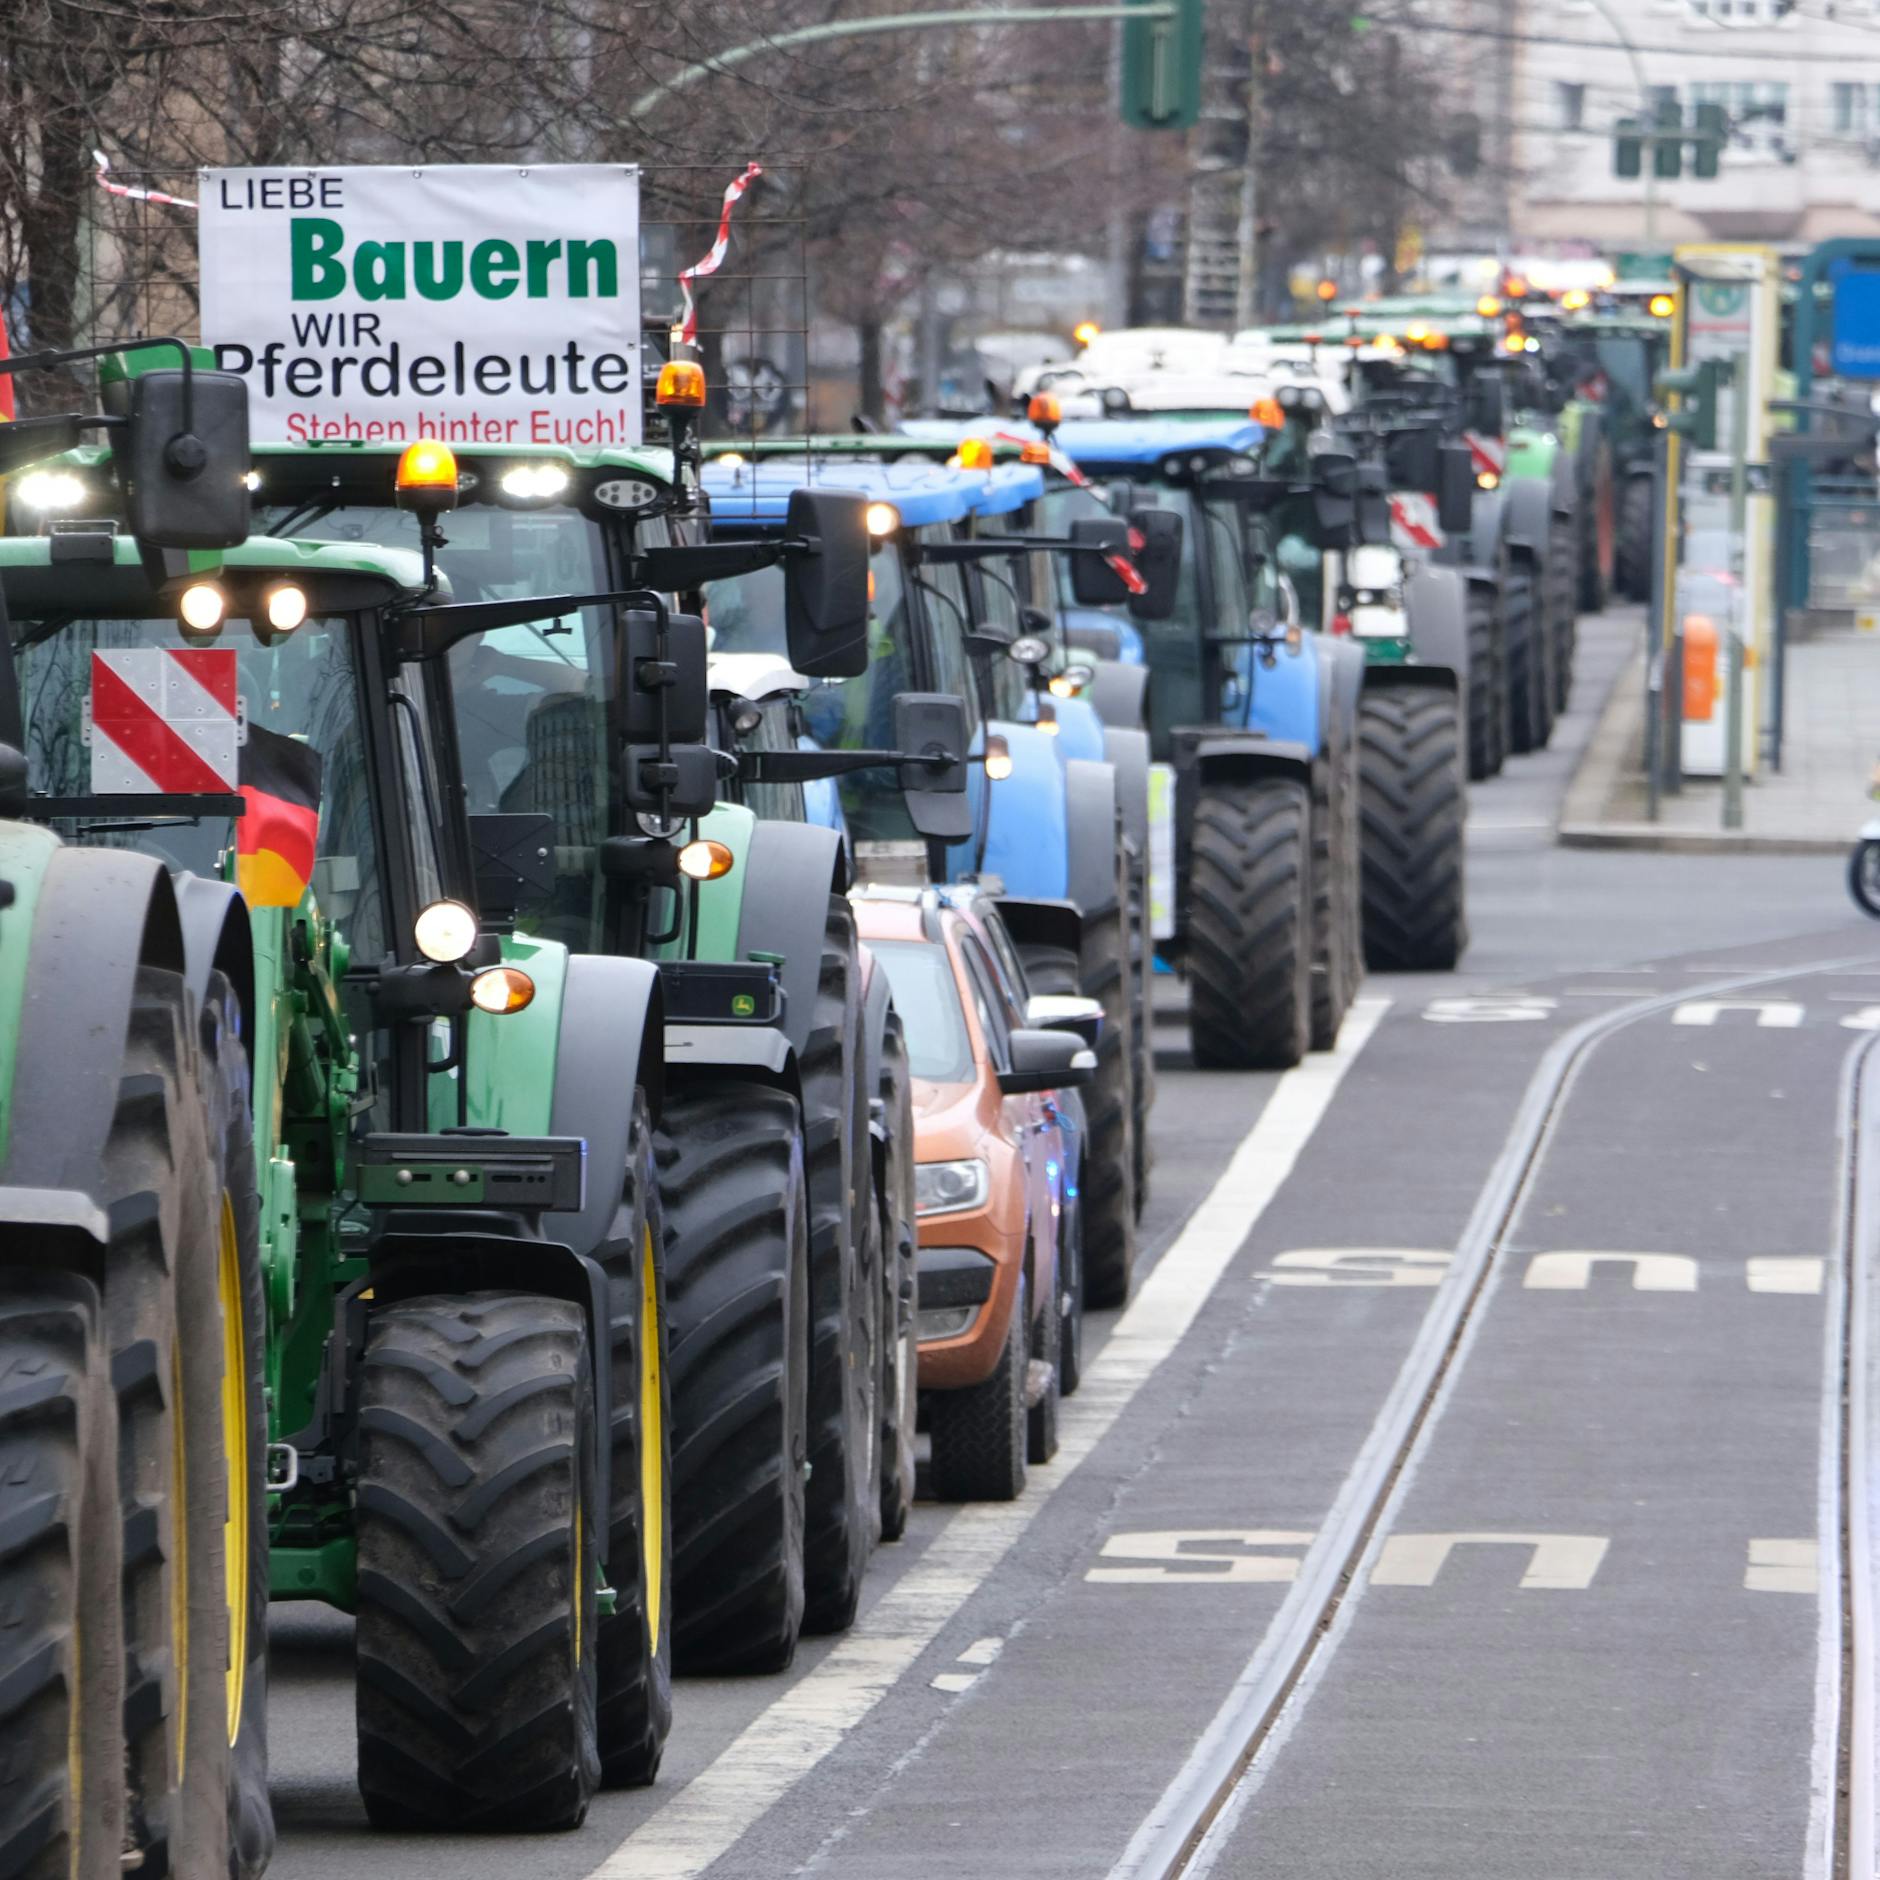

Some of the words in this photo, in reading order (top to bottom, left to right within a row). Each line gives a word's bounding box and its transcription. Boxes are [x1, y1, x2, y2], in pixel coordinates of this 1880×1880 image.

[220, 177, 344, 209] LIEBE
[290, 216, 619, 302] Bauern
[291, 312, 382, 348] WIR
[213, 340, 629, 399] Pferdeleute
[286, 412, 406, 442] Stehen
[418, 410, 519, 443] hinter
[530, 408, 626, 445] Euch!
